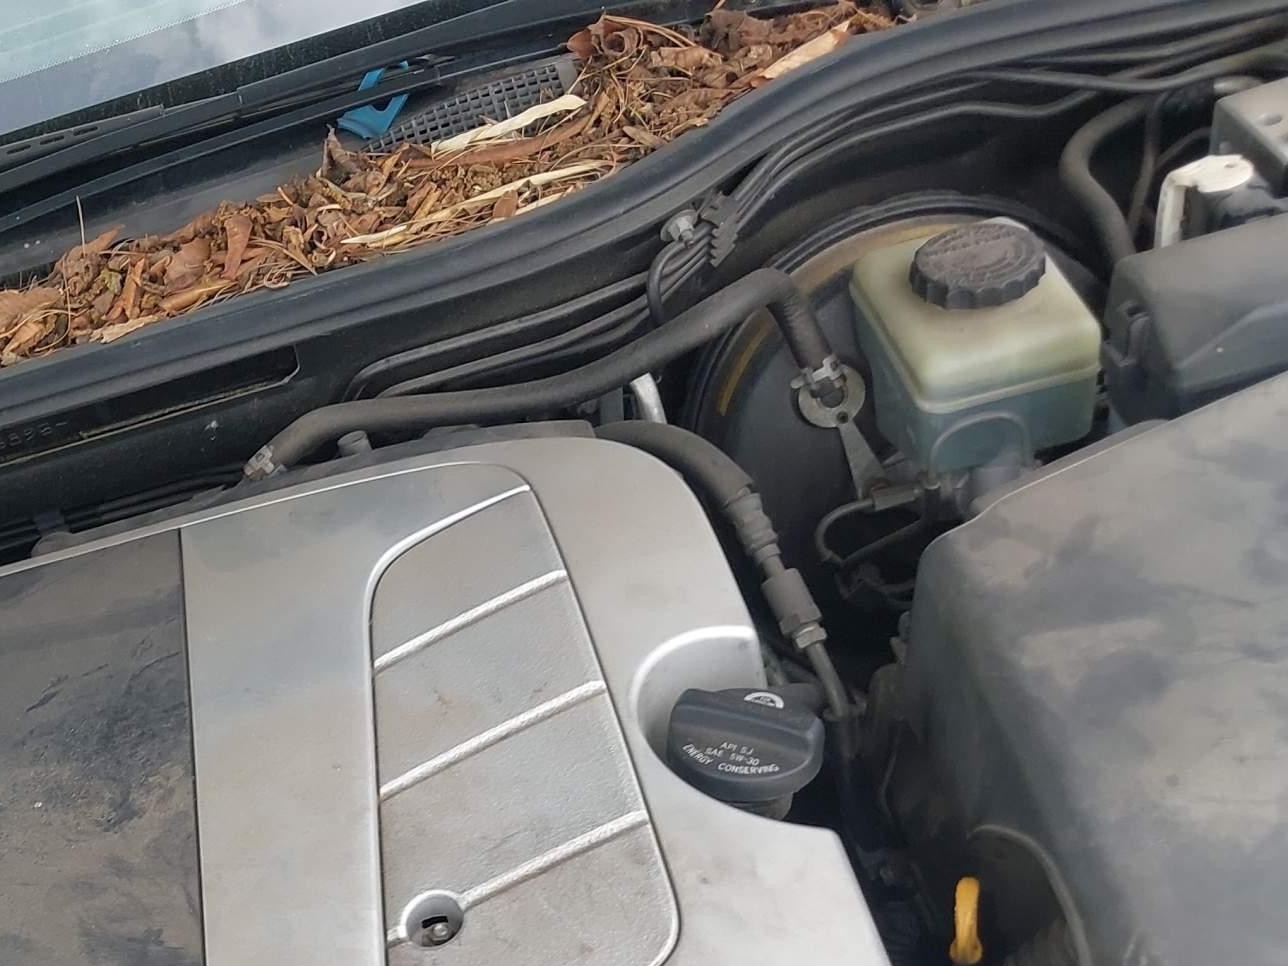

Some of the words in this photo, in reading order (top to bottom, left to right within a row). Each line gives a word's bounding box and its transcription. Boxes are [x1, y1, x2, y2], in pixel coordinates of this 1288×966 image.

[683, 743, 713, 766] ENERGY
[705, 746, 723, 758] SAE
[729, 753, 760, 767] 5W-30
[720, 741, 737, 752] API
